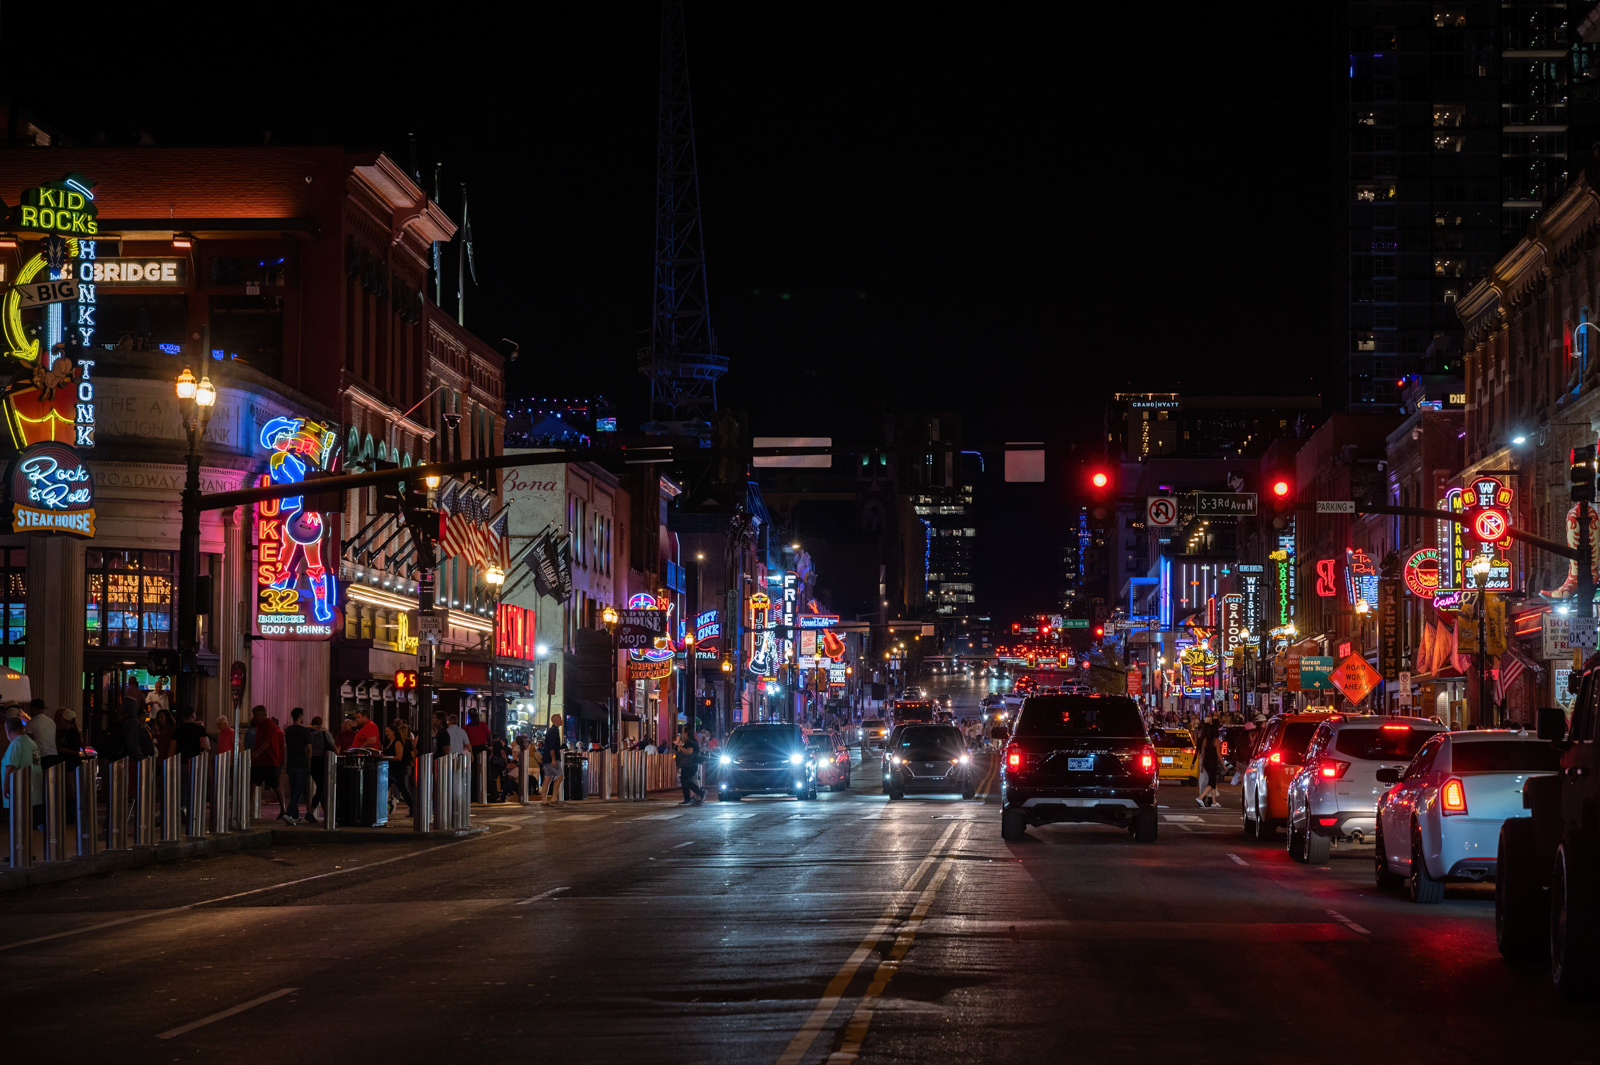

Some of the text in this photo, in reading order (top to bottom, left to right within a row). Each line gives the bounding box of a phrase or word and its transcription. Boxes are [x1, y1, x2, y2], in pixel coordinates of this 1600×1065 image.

[39, 187, 85, 210] KID
[93, 262, 177, 282] BRIDGE
[37, 281, 75, 302] BIG
[78, 240, 96, 347] HONKY
[76, 360, 95, 445] TONK
[1449, 394, 1466, 404] DIE
[20, 456, 90, 485] Rock
[95, 472, 238, 493] ROADWAY RANCH
[28, 482, 91, 508] & Roll
[1463, 491, 1475, 504] WB
[1499, 491, 1511, 504] WB
[1317, 503, 1347, 512] PARKING
[17, 508, 91, 533] STEAKHOUSE
[259, 475, 284, 586] UKE'S
[1453, 497, 1463, 584] MRANDA
[1352, 554, 1371, 563] Tin
[1408, 550, 1438, 568] SAVANN
[1352, 563, 1376, 576] Roof
[1466, 567, 1509, 578] BNT
[1407, 575, 1427, 597] CANDY
[259, 588, 299, 613] 32
[1246, 577, 1256, 633] WHISKEY
[261, 625, 286, 634] FOOD
[296, 625, 331, 635] DRINKS
[698, 623, 720, 641] ONK
[1228, 603, 1239, 650] SALOON
[1384, 585, 1396, 678] VALENTINE
[619, 635, 647, 648] MOJO
[1570, 632, 1581, 643] OK
[409, 674, 416, 687] 5
